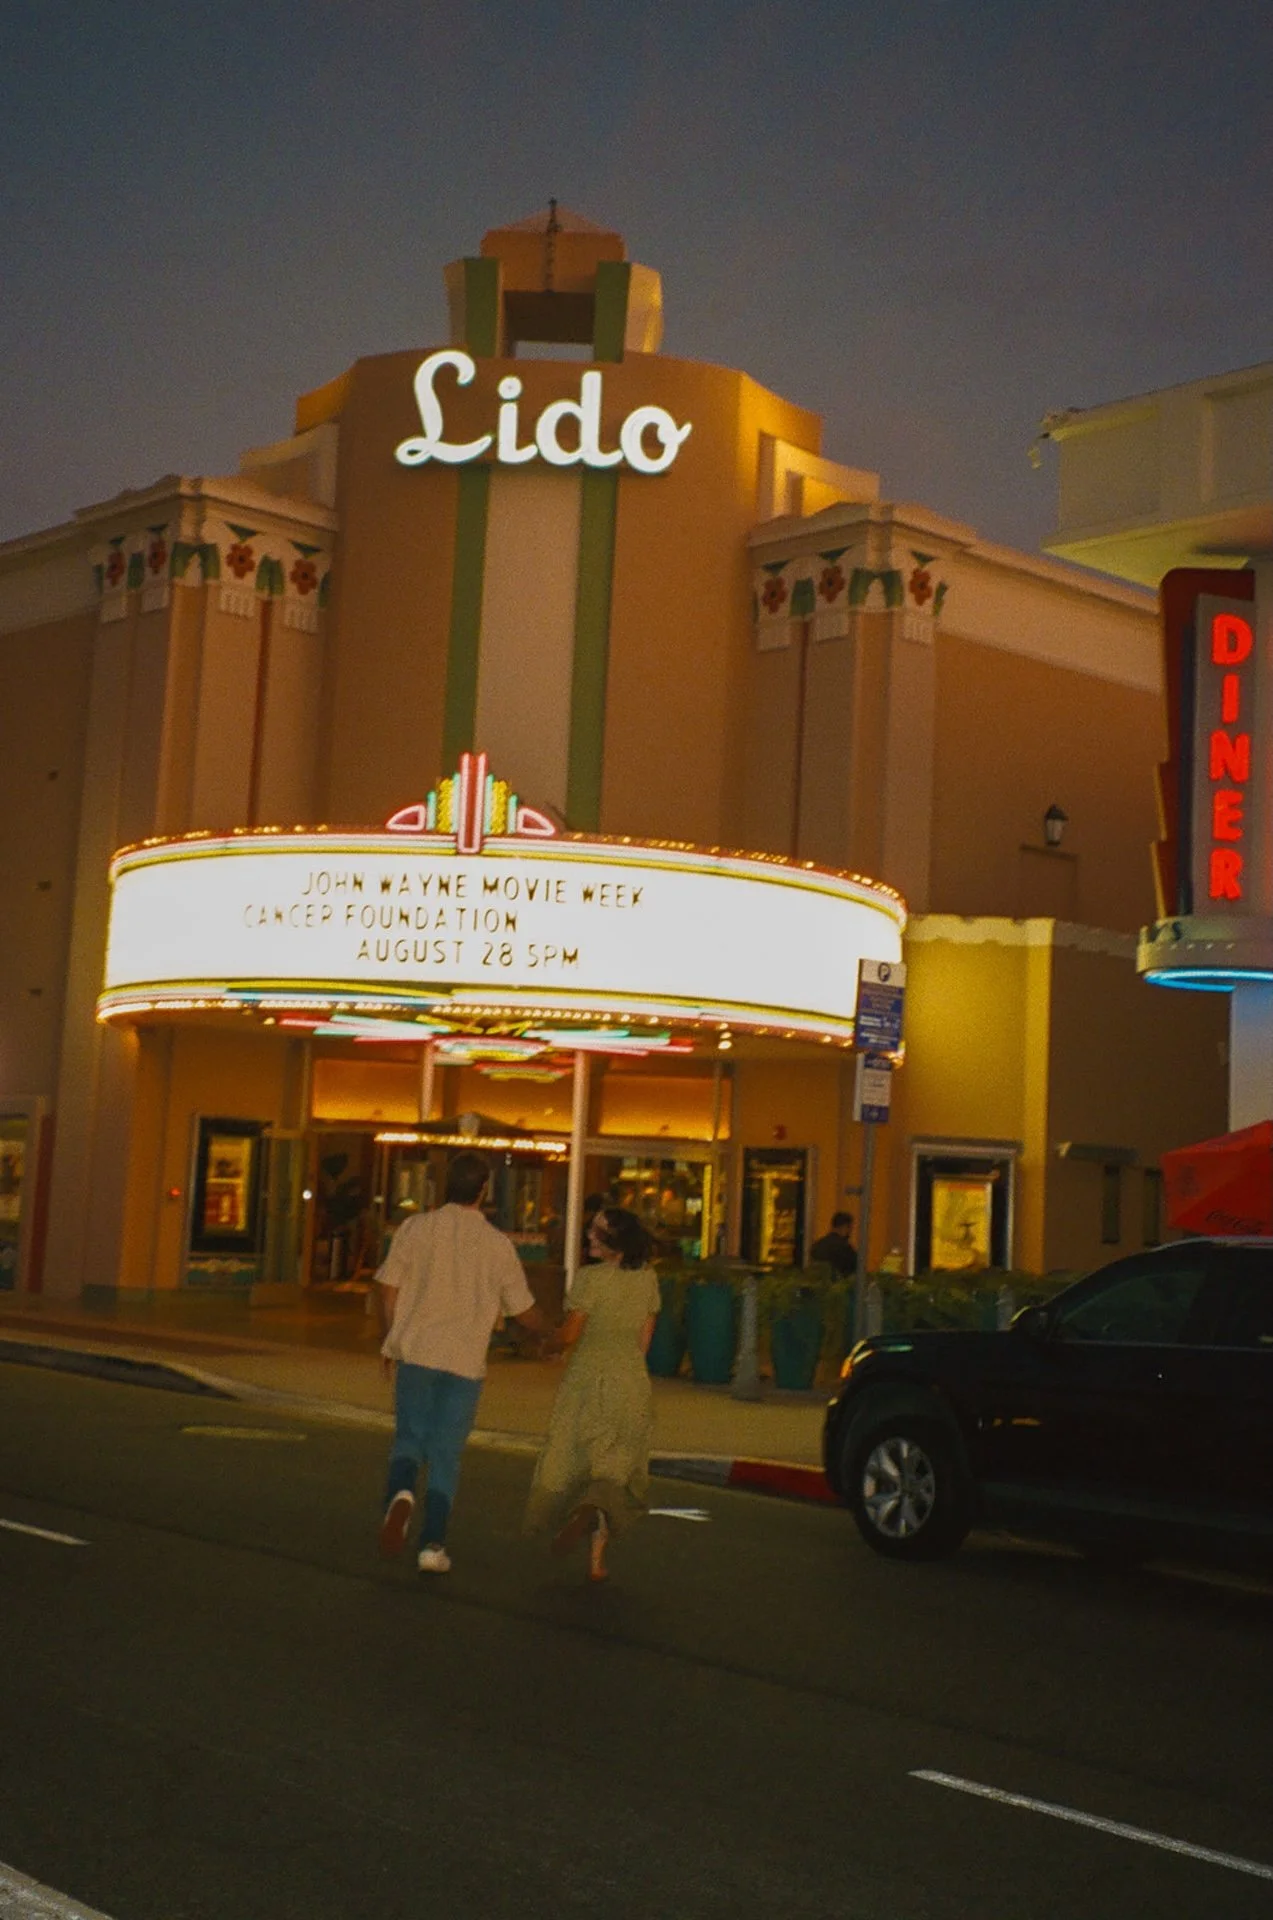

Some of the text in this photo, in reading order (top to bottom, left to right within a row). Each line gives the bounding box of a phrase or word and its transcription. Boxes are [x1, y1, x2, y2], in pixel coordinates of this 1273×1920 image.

[396, 350, 692, 473] Lido
[1209, 613, 1253, 899] DINER
[302, 871, 643, 908] JOHN WAYNE MOVIE WEEK
[345, 903, 518, 932] FOUNDATION
[357, 938, 579, 969] AUGUST 28 5PM
